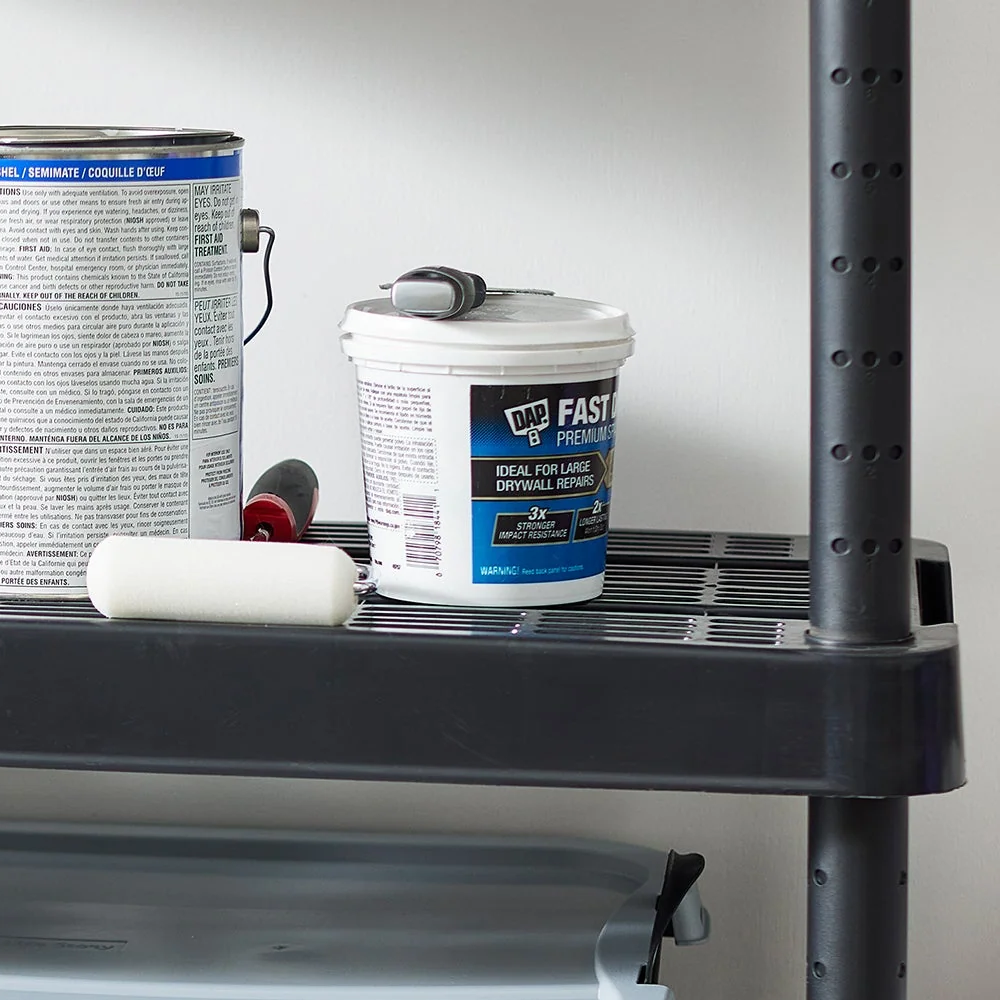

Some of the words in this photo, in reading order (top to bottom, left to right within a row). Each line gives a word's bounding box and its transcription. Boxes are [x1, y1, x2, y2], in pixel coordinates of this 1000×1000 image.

[29, 166, 80, 178] SEMIMATE
[88, 166, 135, 179] COQUILLE
[194, 186, 209, 196] MAY
[210, 184, 232, 194] IRRITATE
[194, 197, 212, 208] EYES.
[214, 196, 220, 206] Do
[194, 212, 209, 222] eyes.
[211, 209, 224, 220] Keep
[195, 221, 212, 232] reach
[212, 221, 218, 232] of
[195, 234, 212, 245] FIRST
[214, 233, 223, 243] AID
[195, 299, 210, 311] PEUT
[194, 312, 212, 324] YEUX.
[214, 309, 227, 322] Éviter
[194, 324, 215, 336] contact
[216, 324, 227, 332] avec
[213, 335, 224, 346] Tenir
[194, 349, 202, 359] de
[204, 349, 208, 359] la
[209, 348, 225, 360] portée
[194, 373, 215, 385] SOINS.
[558, 393, 610, 426] FAST
[557, 426, 607, 447] PREMIUM
[496, 465, 532, 477] IDEAL
[535, 464, 558, 476] FOR
[561, 460, 591, 475] LARGE
[496, 478, 553, 492] DRYWALL
[557, 474, 594, 490] REPAIRS
[528, 506, 547, 520] 3x
[592, 500, 602, 514] 2x
[516, 520, 556, 530] STRONGER
[499, 530, 526, 540] IMPACT
[528, 528, 567, 539] RESISTANCE
